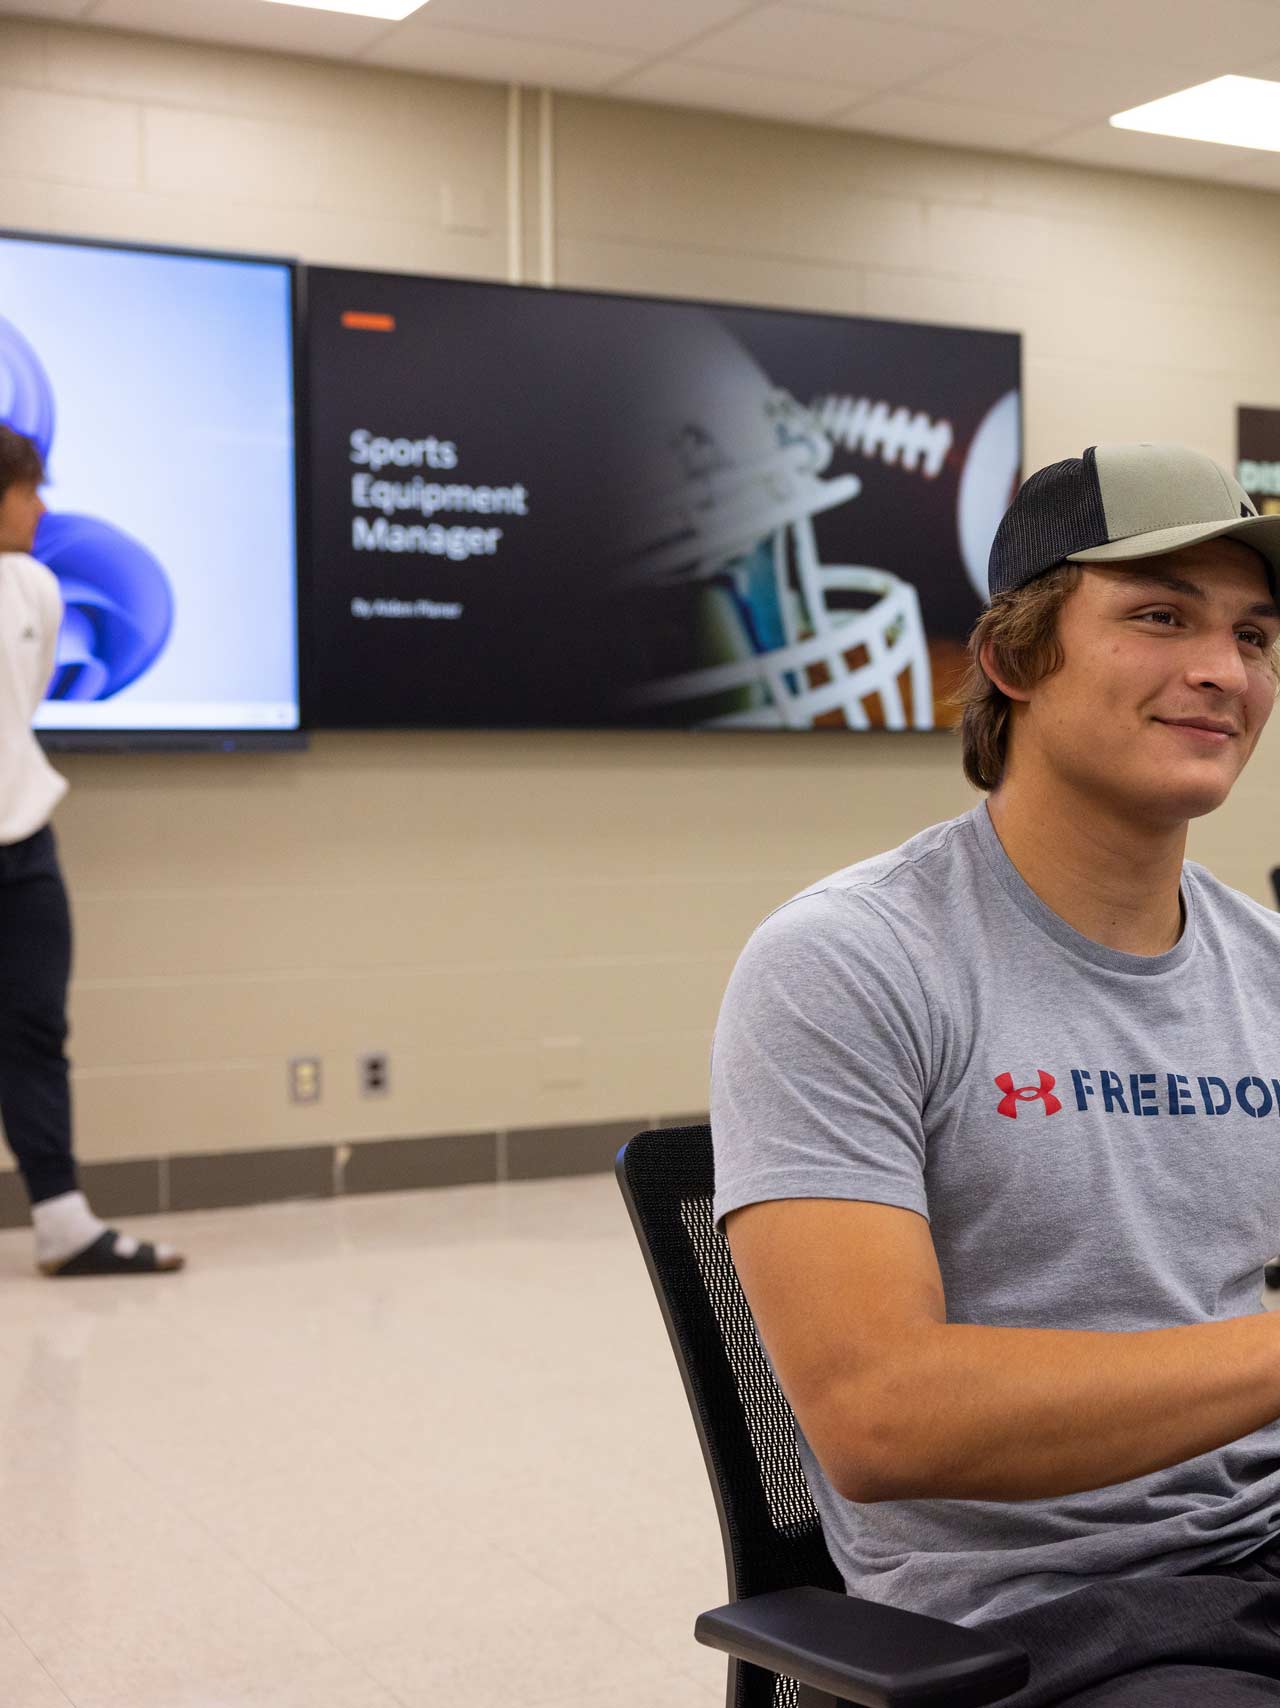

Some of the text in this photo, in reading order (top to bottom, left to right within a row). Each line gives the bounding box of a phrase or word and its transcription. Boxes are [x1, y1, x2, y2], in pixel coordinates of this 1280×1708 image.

[350, 428, 458, 471] Sports
[351, 473, 529, 518] Equipment
[351, 516, 503, 561] Manager
